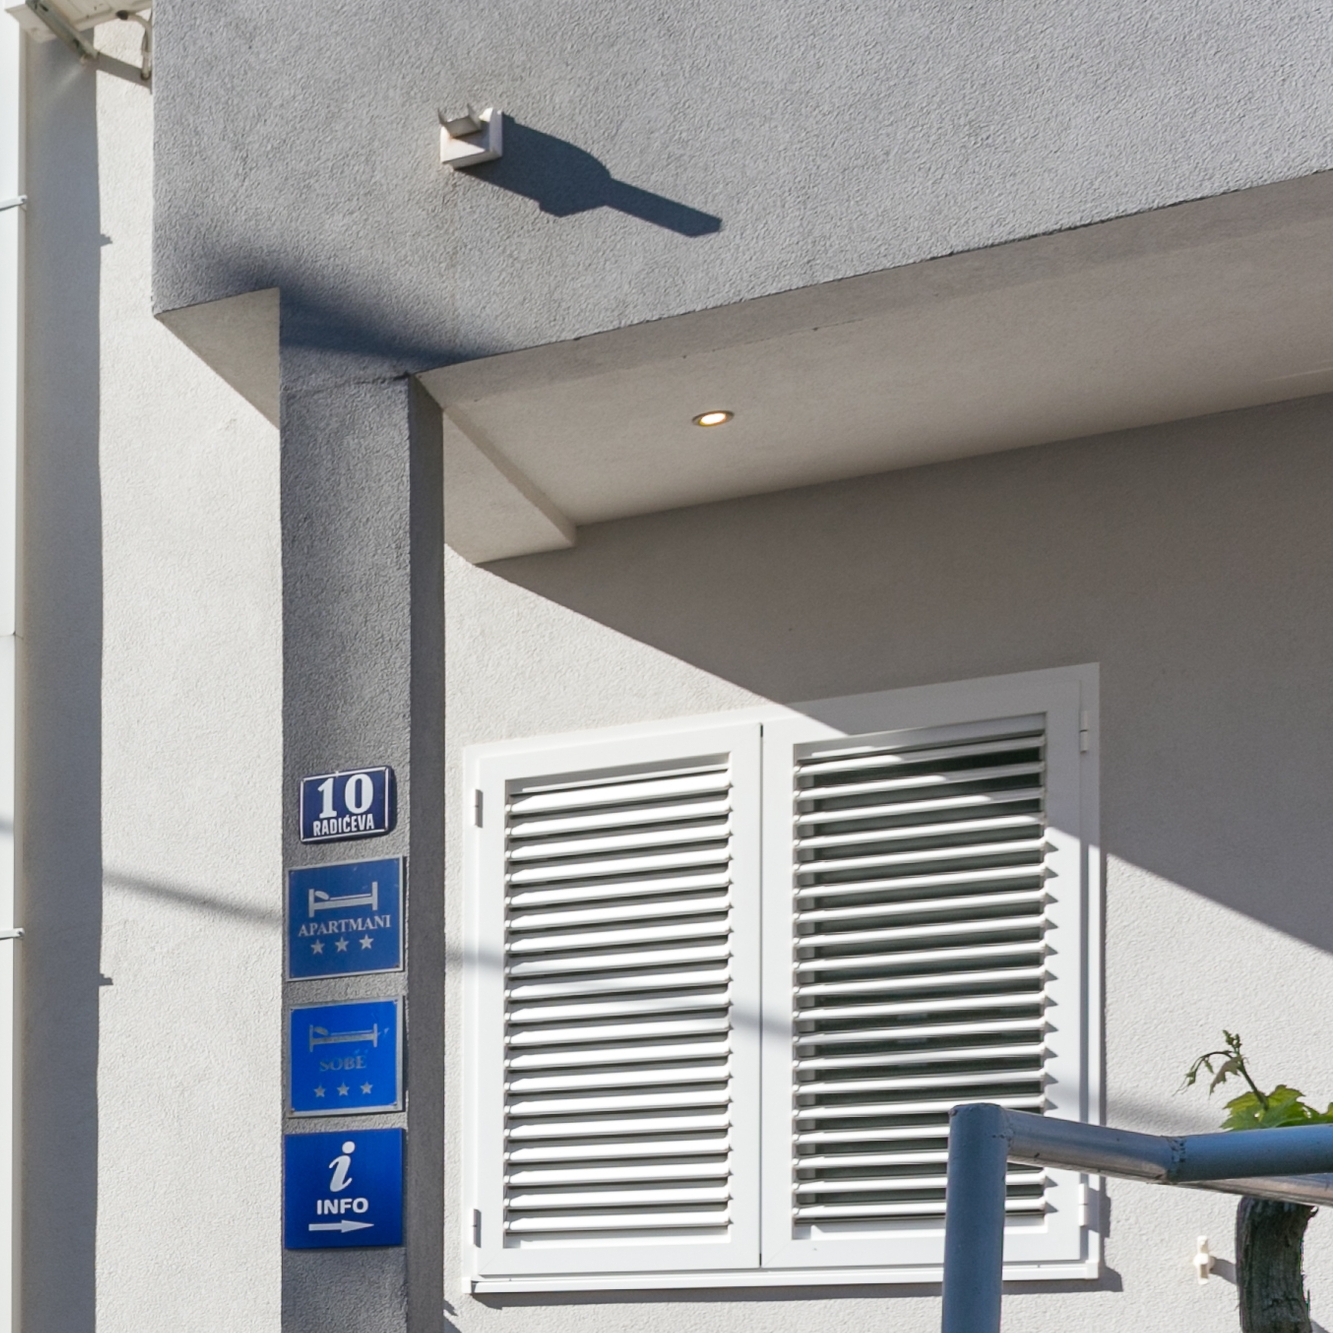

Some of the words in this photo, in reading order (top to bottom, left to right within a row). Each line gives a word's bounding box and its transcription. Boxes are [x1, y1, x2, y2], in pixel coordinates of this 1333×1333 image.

[317, 773, 373, 819] 10
[313, 813, 374, 836] RADIĆEVA
[298, 915, 391, 937] APARTMANI
[319, 1055, 367, 1072] SOBE
[317, 1197, 369, 1215] INFO
